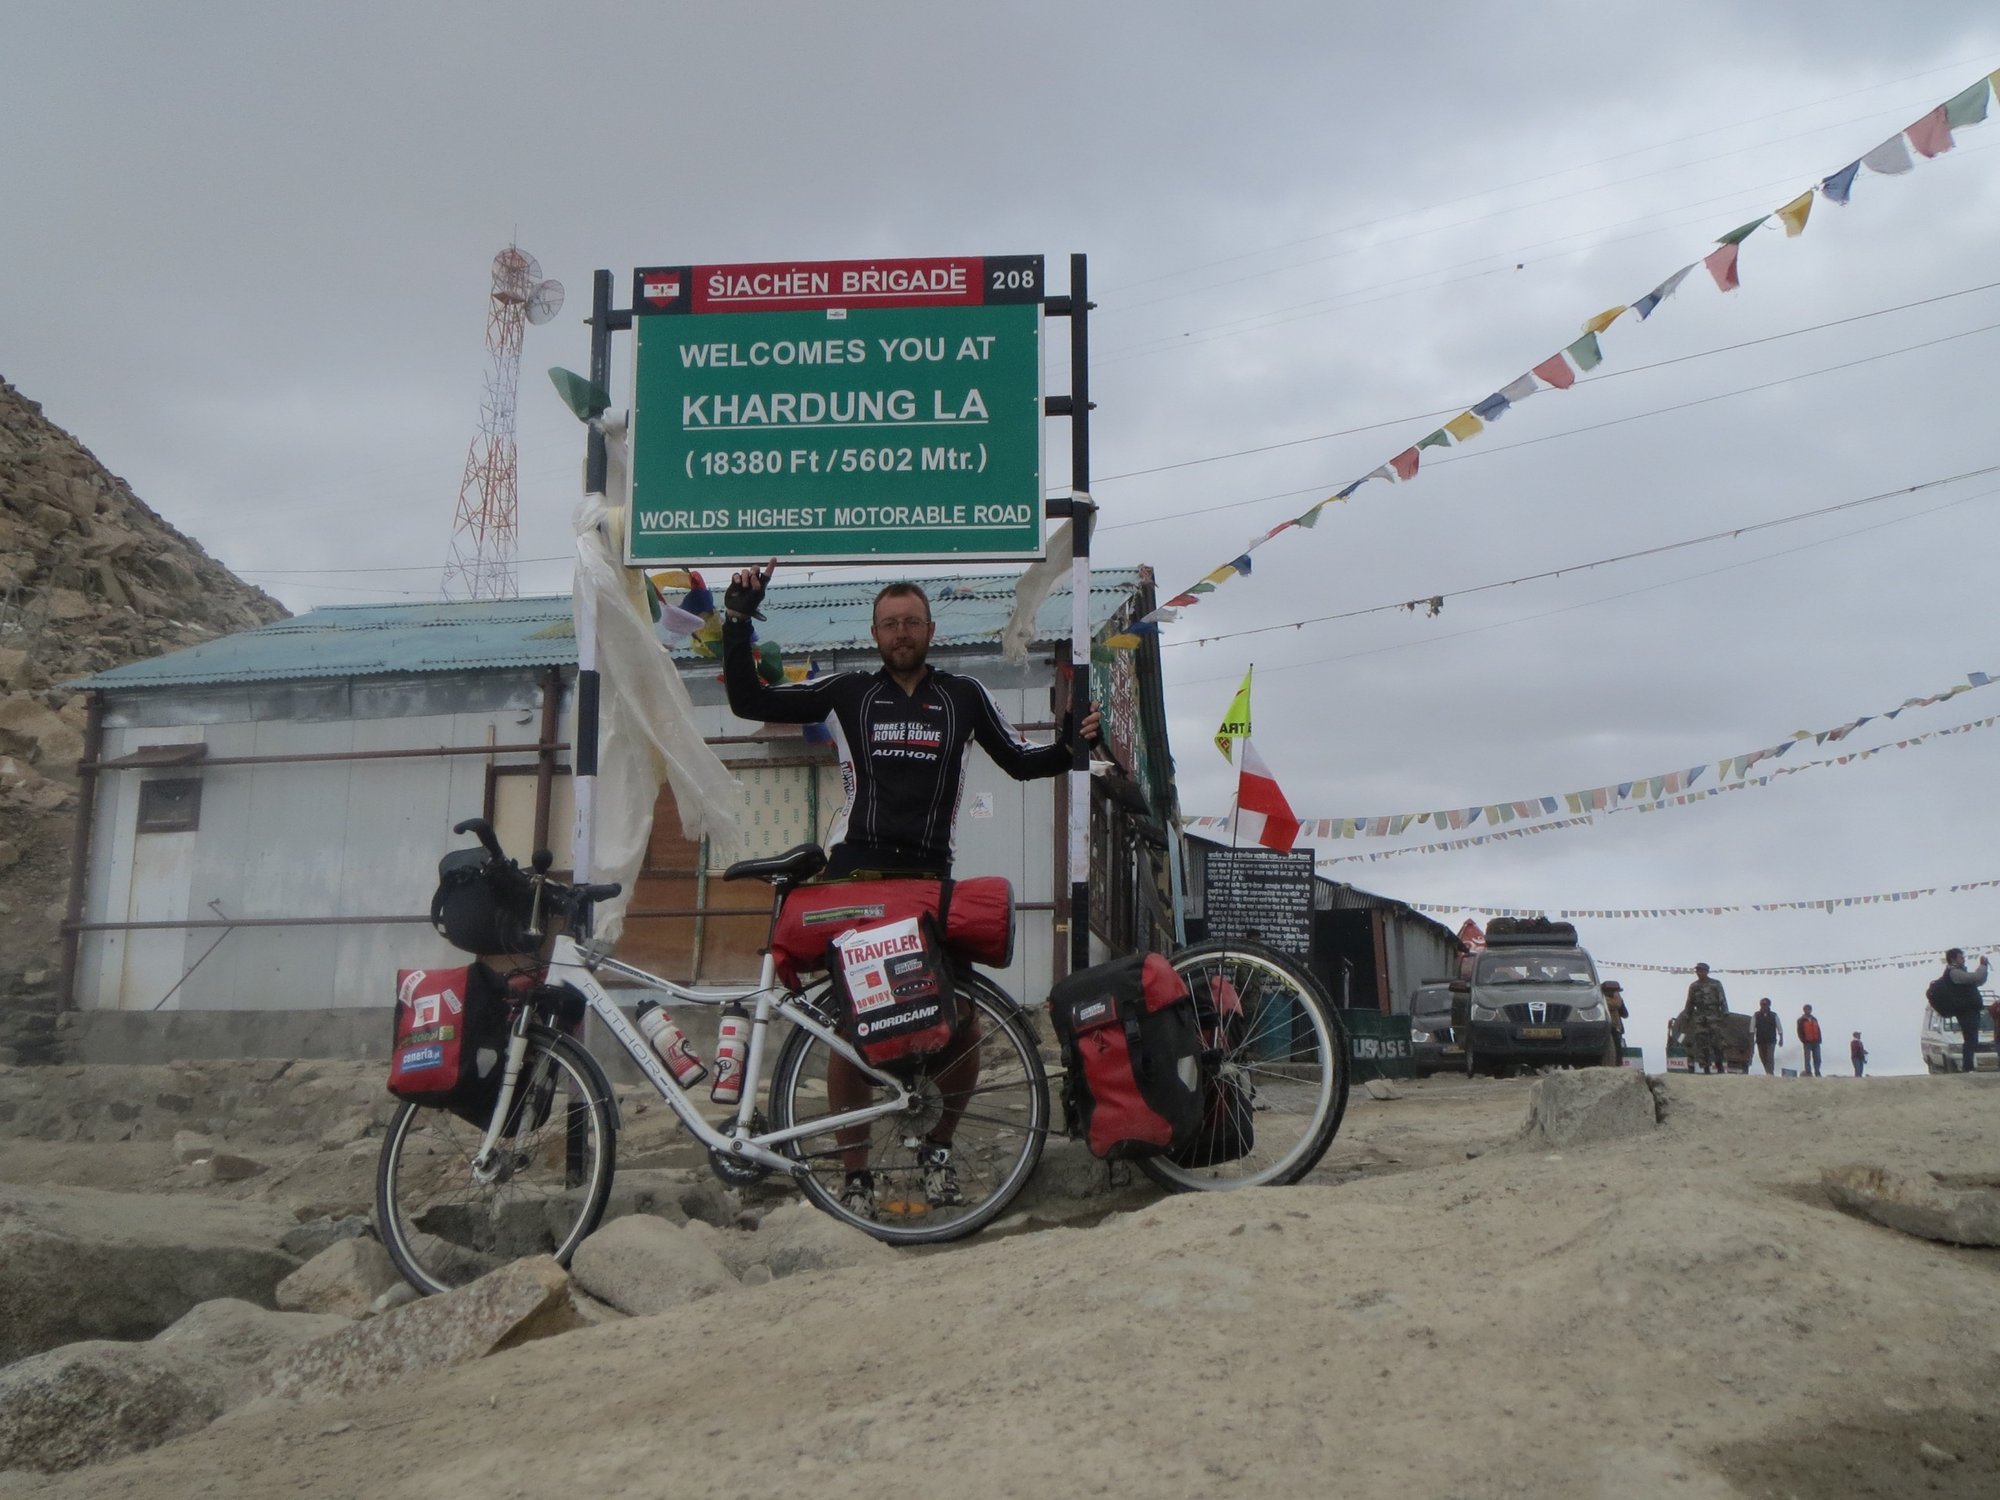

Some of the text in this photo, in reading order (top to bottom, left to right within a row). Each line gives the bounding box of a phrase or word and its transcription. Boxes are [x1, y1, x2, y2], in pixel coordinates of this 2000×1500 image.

[708, 268, 967, 297] SIACHEN BRIGADE
[992, 270, 1035, 290] 208
[679, 336, 996, 368] WELCOMES YOU AT
[682, 388, 990, 425] KHARDUNG LA
[737, 507, 827, 528] HIGHEST
[834, 505, 966, 526] MOTORABLE
[974, 504, 1031, 524] ROAD
[872, 749, 938, 761] AUTHOR
[845, 934, 919, 966] TRAVELER
[583, 981, 661, 1076] AUTHOR
[870, 1005, 939, 1032] NORDCAMP
